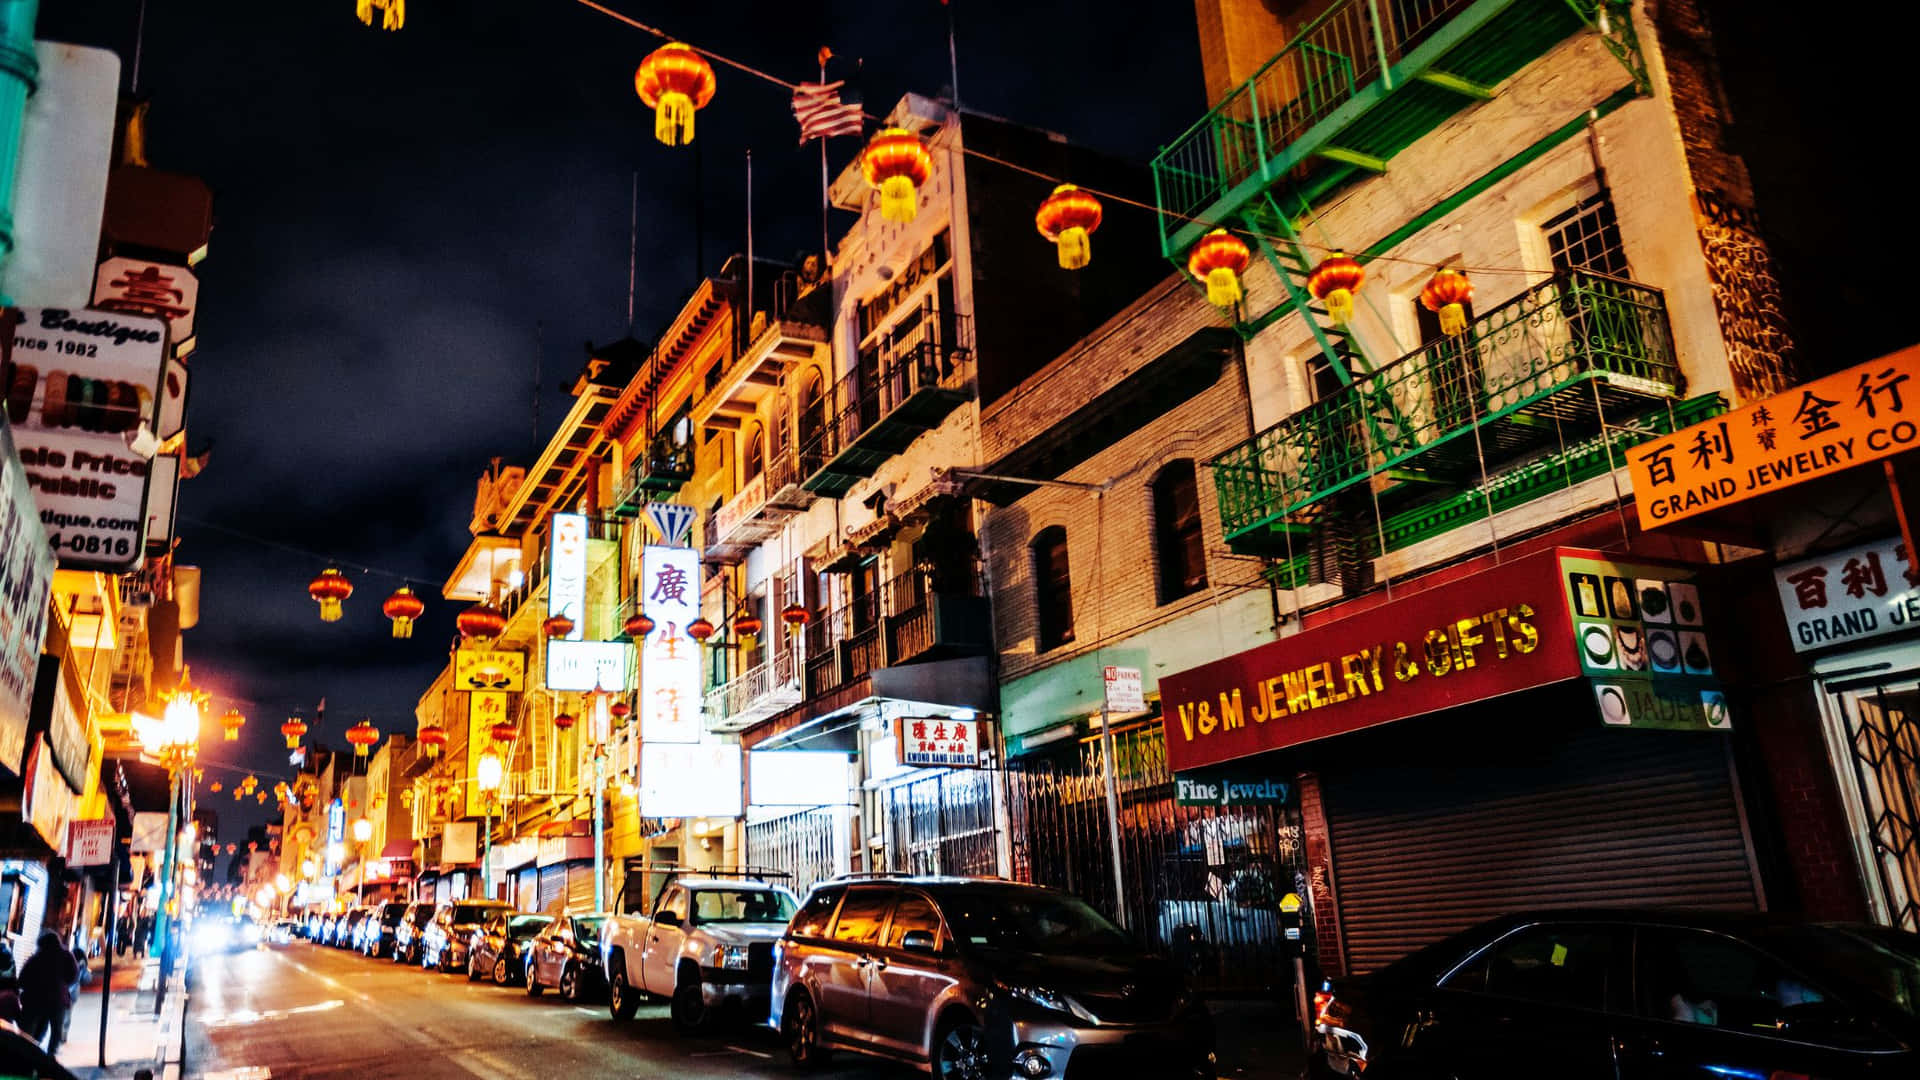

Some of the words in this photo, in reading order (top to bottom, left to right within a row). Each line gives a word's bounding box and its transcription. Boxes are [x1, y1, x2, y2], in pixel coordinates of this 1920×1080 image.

[41, 309, 160, 346] Boutique
[14, 337, 48, 351] nce
[55, 340, 97, 358] 1982
[72, 450, 146, 477] Price
[26, 472, 117, 500] Public
[1650, 477, 1737, 519] GRAND
[1746, 438, 1855, 491] JEWELRY
[40, 509, 138, 532] tique.com
[49, 533, 130, 555] 4-0816
[1798, 607, 1878, 646] GRAND
[1105, 668, 1117, 680] NO
[1251, 645, 1385, 723] JEWELRY
[1394, 641, 1419, 682] &
[1424, 603, 1539, 678] GIFTS
[1177, 779, 1219, 800] Fine
[1221, 778, 1289, 805] Jewelry
